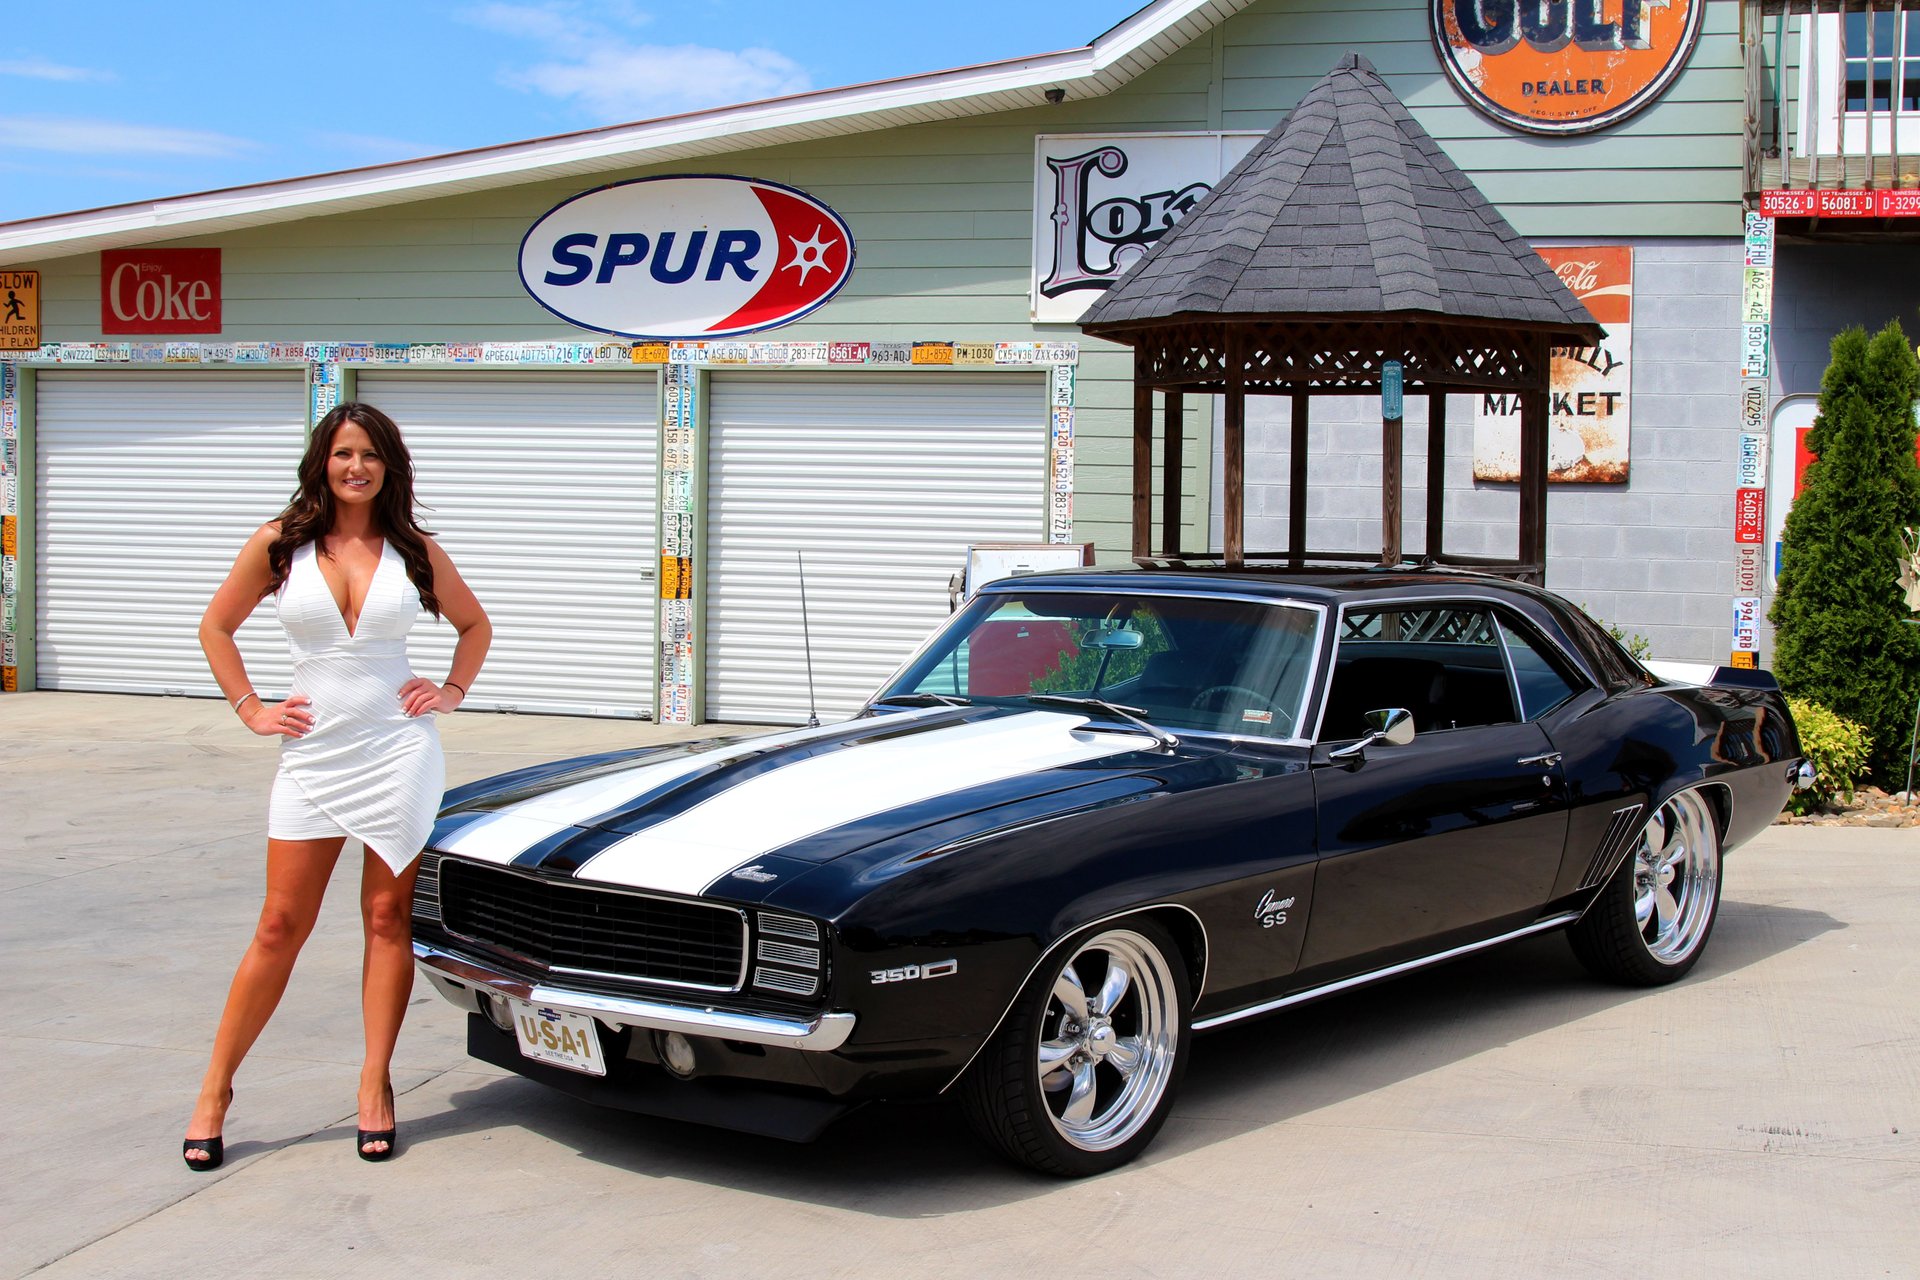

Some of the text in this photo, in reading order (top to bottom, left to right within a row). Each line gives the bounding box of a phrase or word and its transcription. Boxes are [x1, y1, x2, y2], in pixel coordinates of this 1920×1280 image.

[1522, 79, 1606, 96] DEALER
[543, 230, 762, 286] SPUR
[1751, 243, 1766, 265] FHU
[141, 263, 162, 273] Enjoy
[110, 262, 212, 322] Coke
[0, 325, 37, 335] HILDREN
[11, 337, 35, 347] PLAY
[167, 349, 180, 358] ASE
[304, 347, 320, 357] 435
[341, 347, 374, 357] VCX 315
[375, 348, 389, 359] 318
[447, 347, 483, 358] 545 HCV
[577, 347, 593, 359] FGK
[617, 348, 632, 359] 782
[711, 348, 727, 360] ASE
[1058, 429, 1068, 447] 120
[1056, 468, 1067, 490] 5219
[1739, 601, 1753, 649] 994 ERB
[1262, 911, 1287, 929] SS
[868, 964, 921, 985] 350
